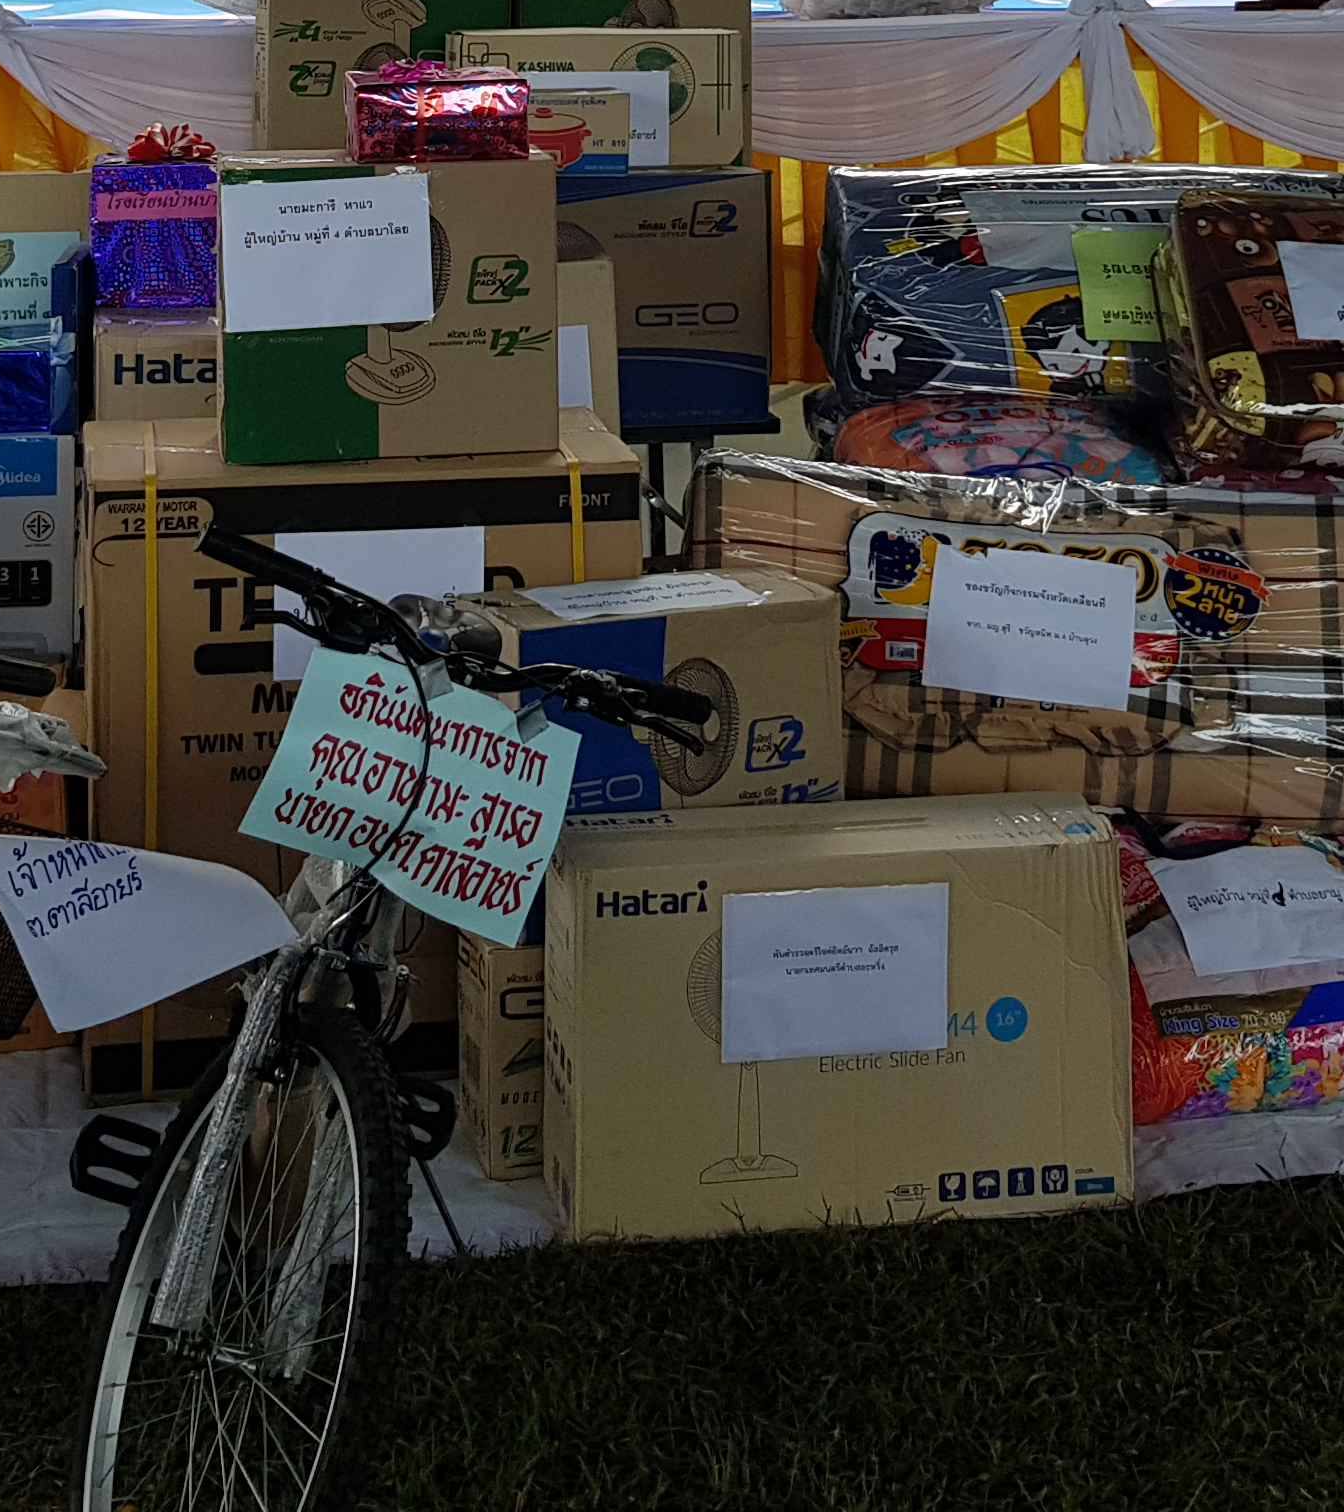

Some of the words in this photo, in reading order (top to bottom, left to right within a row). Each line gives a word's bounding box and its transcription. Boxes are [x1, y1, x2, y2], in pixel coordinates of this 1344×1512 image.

[517, 61, 576, 72] KASHIWA
[244, 230, 301, 249] ผู้ใหญ่บ้าน
[635, 302, 739, 327] GEO
[113, 353, 217, 385] Hata
[107, 501, 161, 513] WARRANY
[163, 500, 197, 512] MOTOR
[121, 519, 145, 533] 12
[156, 515, 199, 530] YEAR
[0, 566, 10, 582] 3
[1175, 573, 1203, 608] 2
[1202, 581, 1245, 609] หน้า
[1197, 597, 1239, 625] ลาย
[181, 734, 244, 755] TWIN
[595, 879, 709, 919] Hatari
[1162, 1017, 1205, 1036] King
[1205, 1012, 1240, 1030] Size
[818, 1053, 883, 1075] Electric
[888, 1049, 931, 1070] Slide
[936, 1047, 966, 1066] Fan
